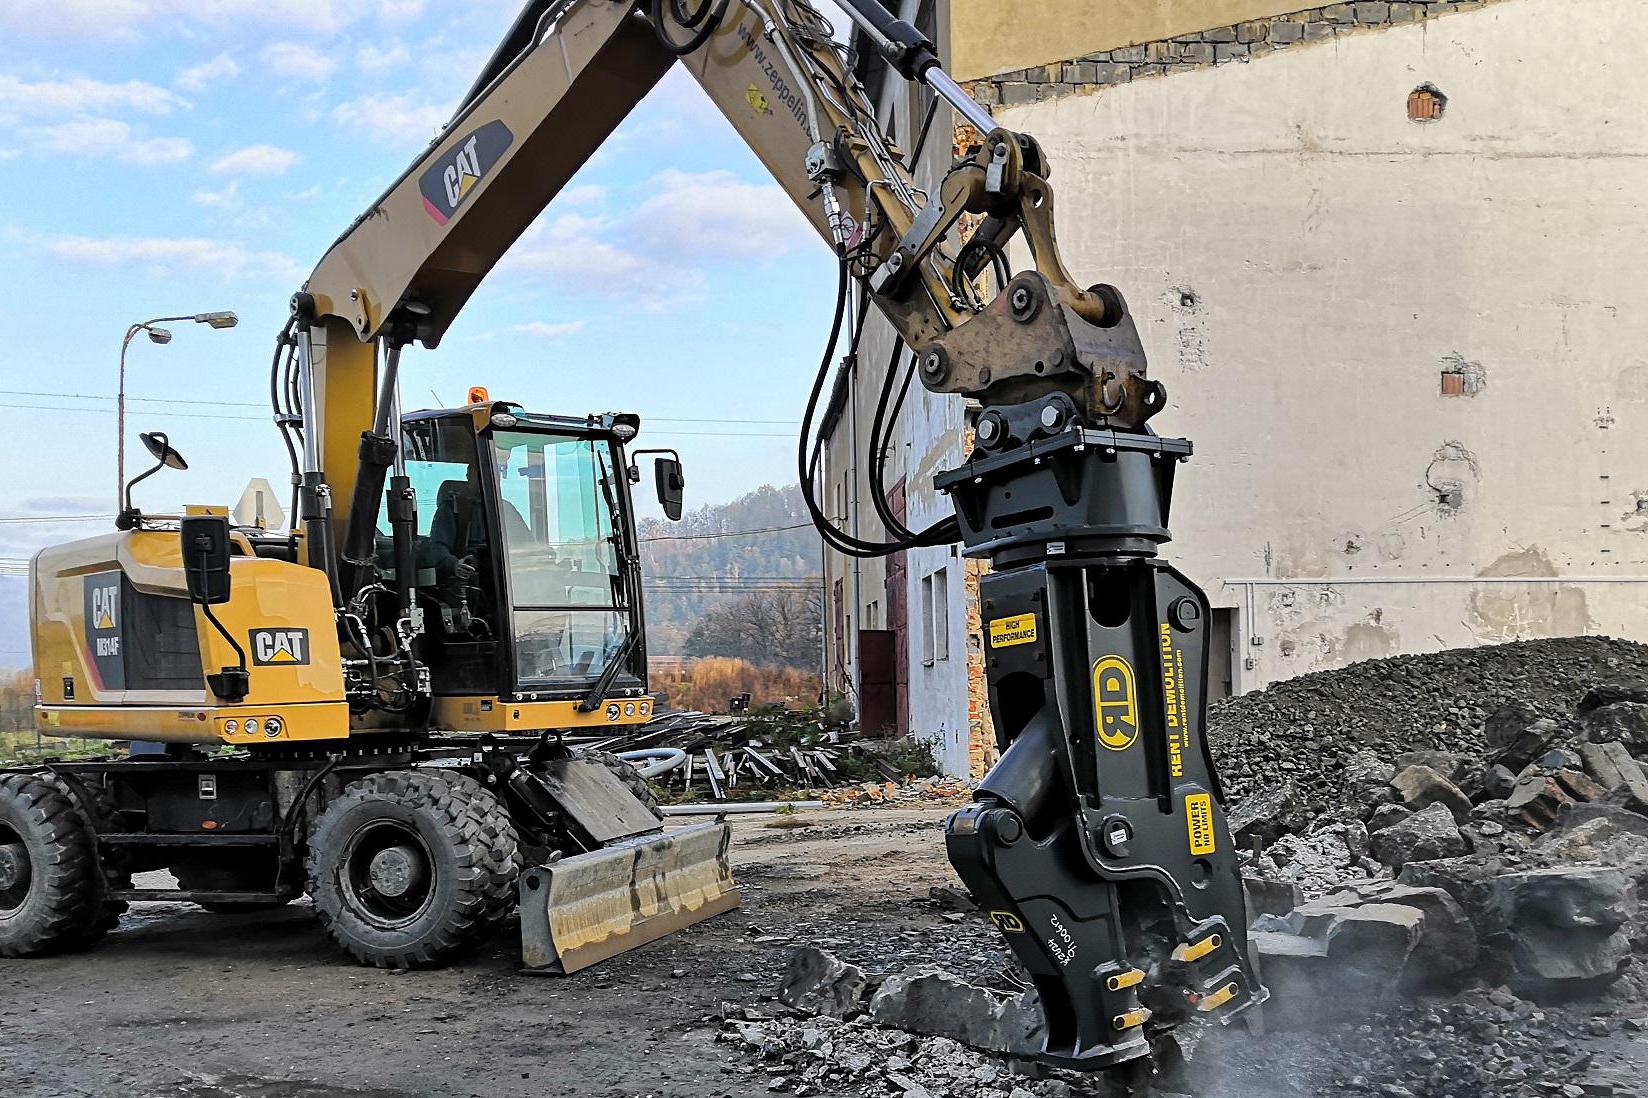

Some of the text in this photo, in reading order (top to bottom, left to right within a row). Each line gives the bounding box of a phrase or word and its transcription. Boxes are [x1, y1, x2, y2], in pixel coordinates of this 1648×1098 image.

[443, 135, 481, 208] CAT
[92, 586, 118, 629] CAT
[1005, 620, 1020, 630] HIGH
[96, 636, 120, 657] M314F
[255, 631, 303, 662] CAT
[992, 628, 1035, 644] PERFORMANCE
[1160, 623, 1183, 777] RENT DEMOLITION
[1175, 649, 1189, 748] www.rentdemolition.com
[1190, 801, 1203, 848] POWER
[1199, 800, 1211, 847] NO LIMITS
